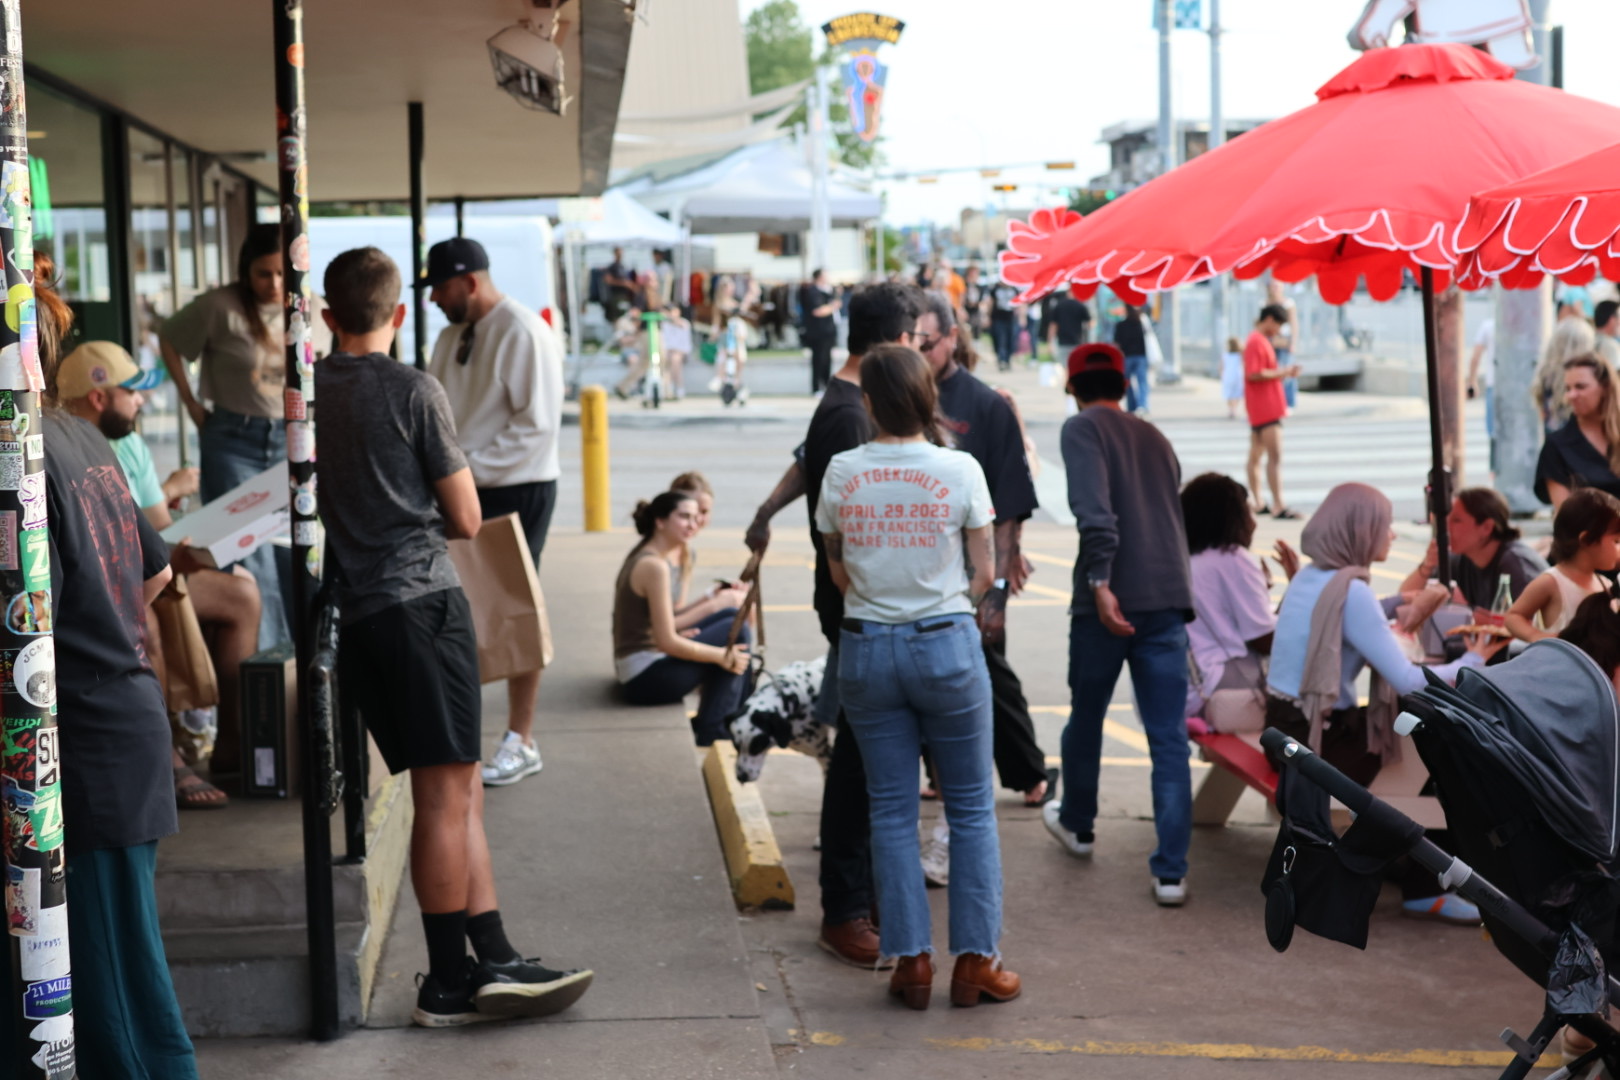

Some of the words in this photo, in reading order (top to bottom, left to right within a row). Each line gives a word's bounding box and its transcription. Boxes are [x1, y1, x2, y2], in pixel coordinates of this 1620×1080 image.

[935, 486, 950, 500] 9
[838, 503, 950, 519] APRIL.29.2023
[839, 521, 864, 534] SAN
[868, 521, 946, 534] FRANCISCO
[847, 535, 882, 548] MARE
[887, 535, 937, 549] ISLAND
[31, 985, 45, 999] 21
